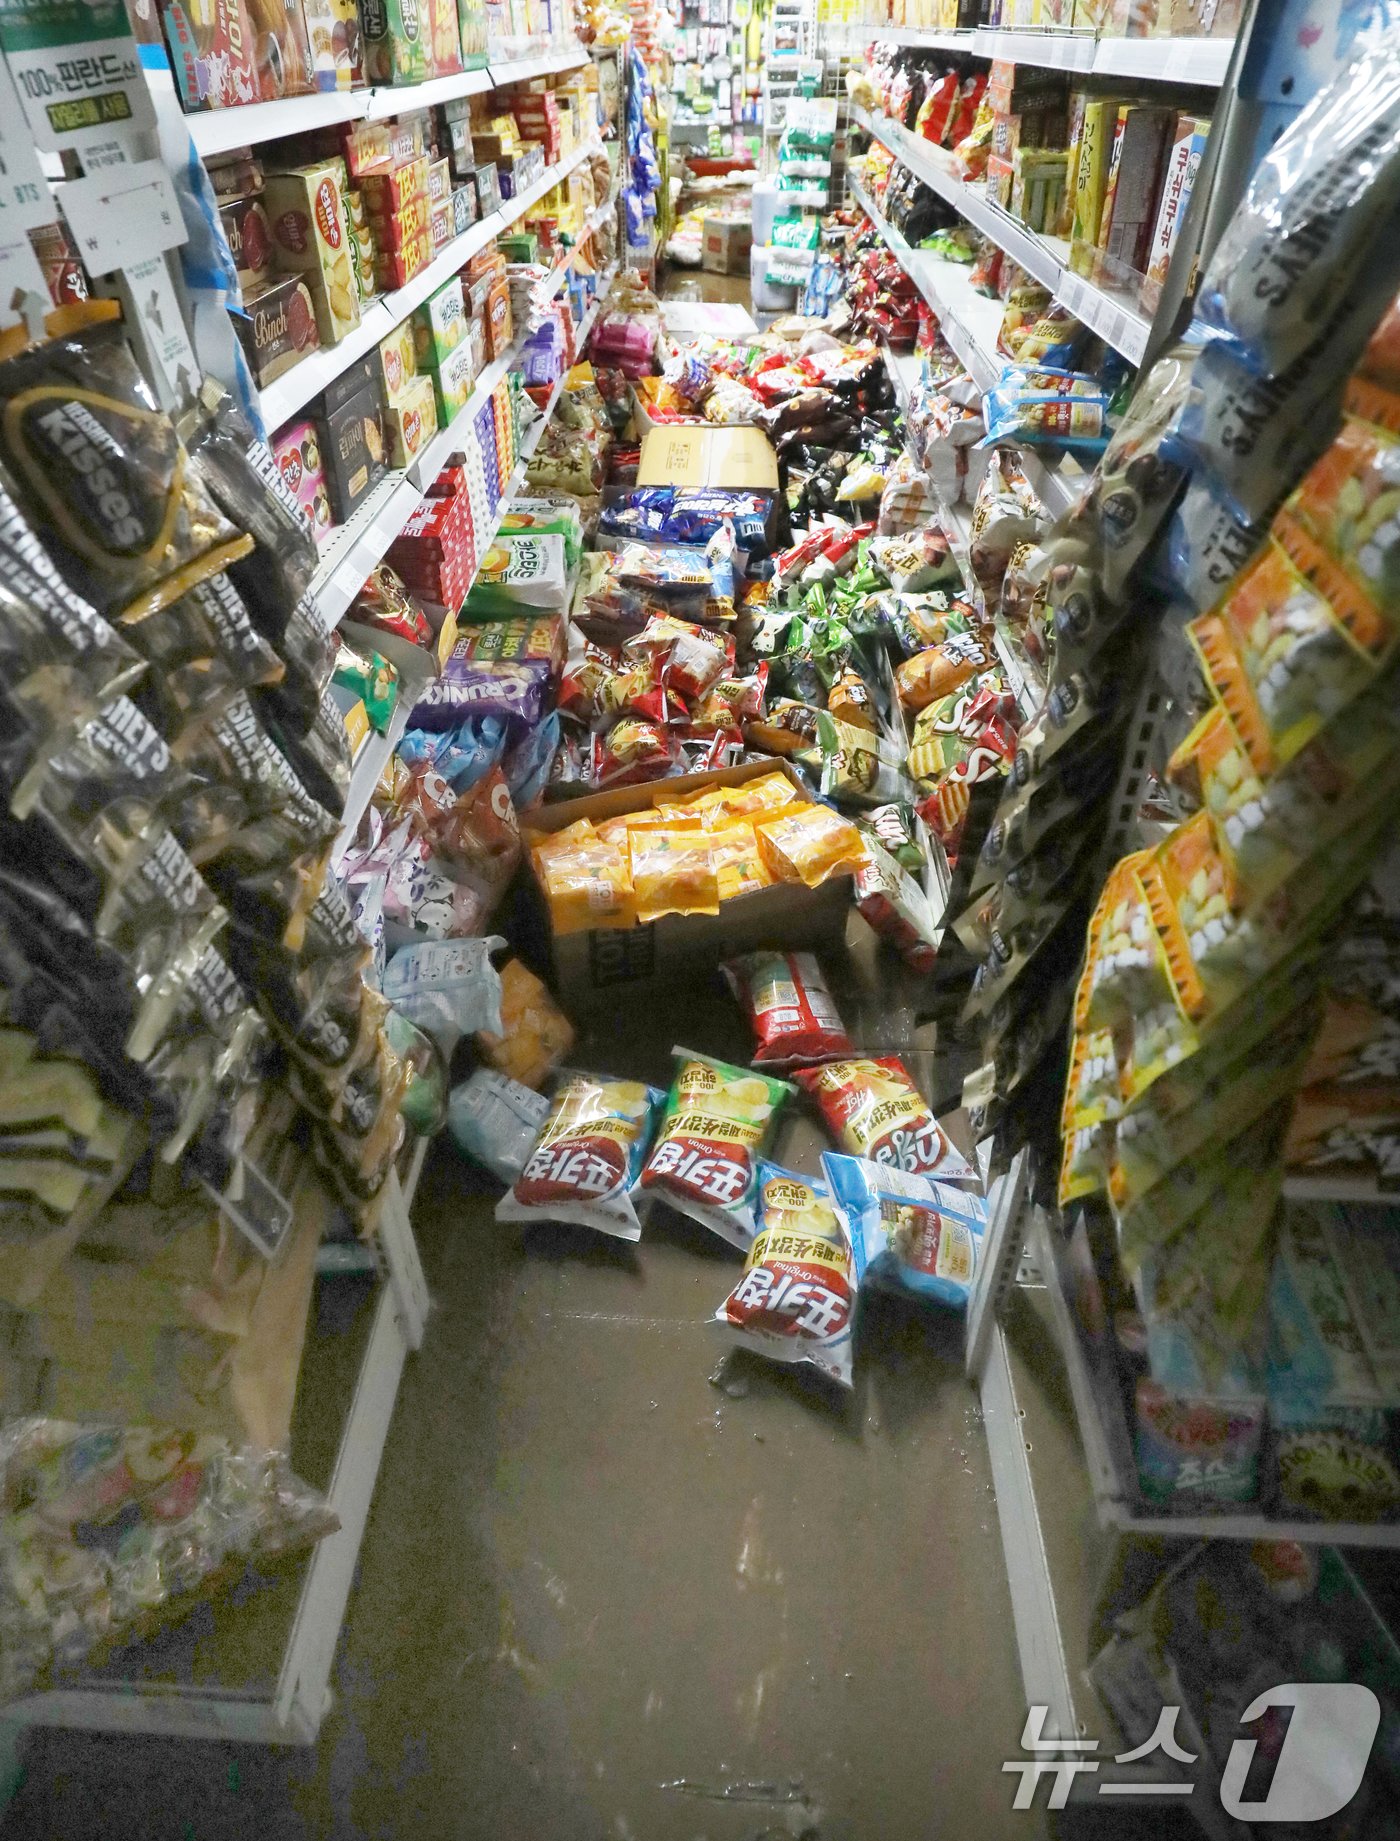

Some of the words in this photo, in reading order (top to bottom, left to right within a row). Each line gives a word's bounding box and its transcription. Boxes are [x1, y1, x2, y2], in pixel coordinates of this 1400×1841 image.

[254, 301, 288, 349] Binch
[61, 401, 125, 457] HERSHEY'S
[283, 459, 301, 484] 칸쵸
[514, 540, 538, 579] 카스타드
[422, 677, 529, 706] CRUNKY
[843, 1089, 868, 1116] Hot
[720, 1122, 741, 1137] 제철
[686, 1138, 714, 1155] Onion
[523, 1147, 620, 1193] 포카칩
[648, 1141, 750, 1203] 포카칩
[766, 1183, 808, 1200] 햇감자
[812, 1242, 836, 1262] 제철
[773, 1260, 812, 1282] Original
[733, 1266, 849, 1338] 포카칩
